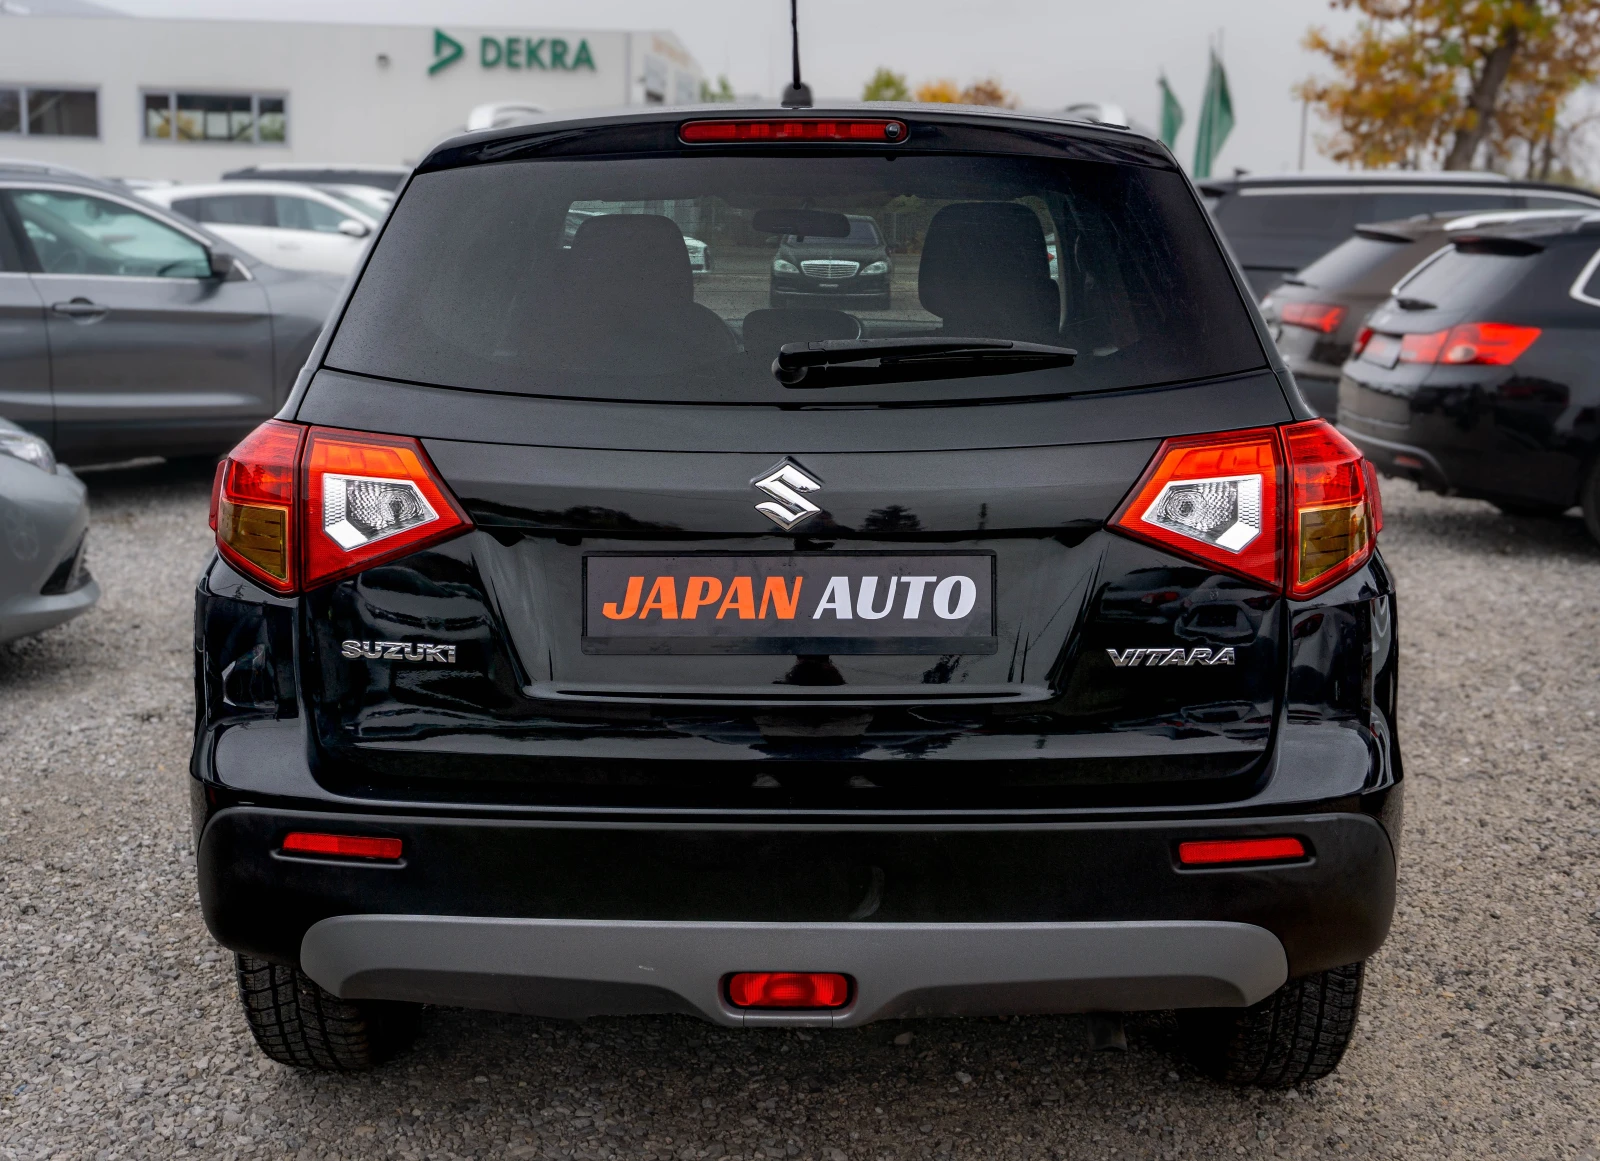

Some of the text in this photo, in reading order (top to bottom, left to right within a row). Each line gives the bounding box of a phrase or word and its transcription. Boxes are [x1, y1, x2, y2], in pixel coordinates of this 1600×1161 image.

[480, 36, 597, 71] DEKRA
[602, 576, 977, 620] JAPAN AUTO
[341, 640, 456, 663] SUZUKI
[1105, 647, 1236, 667] VITARA
